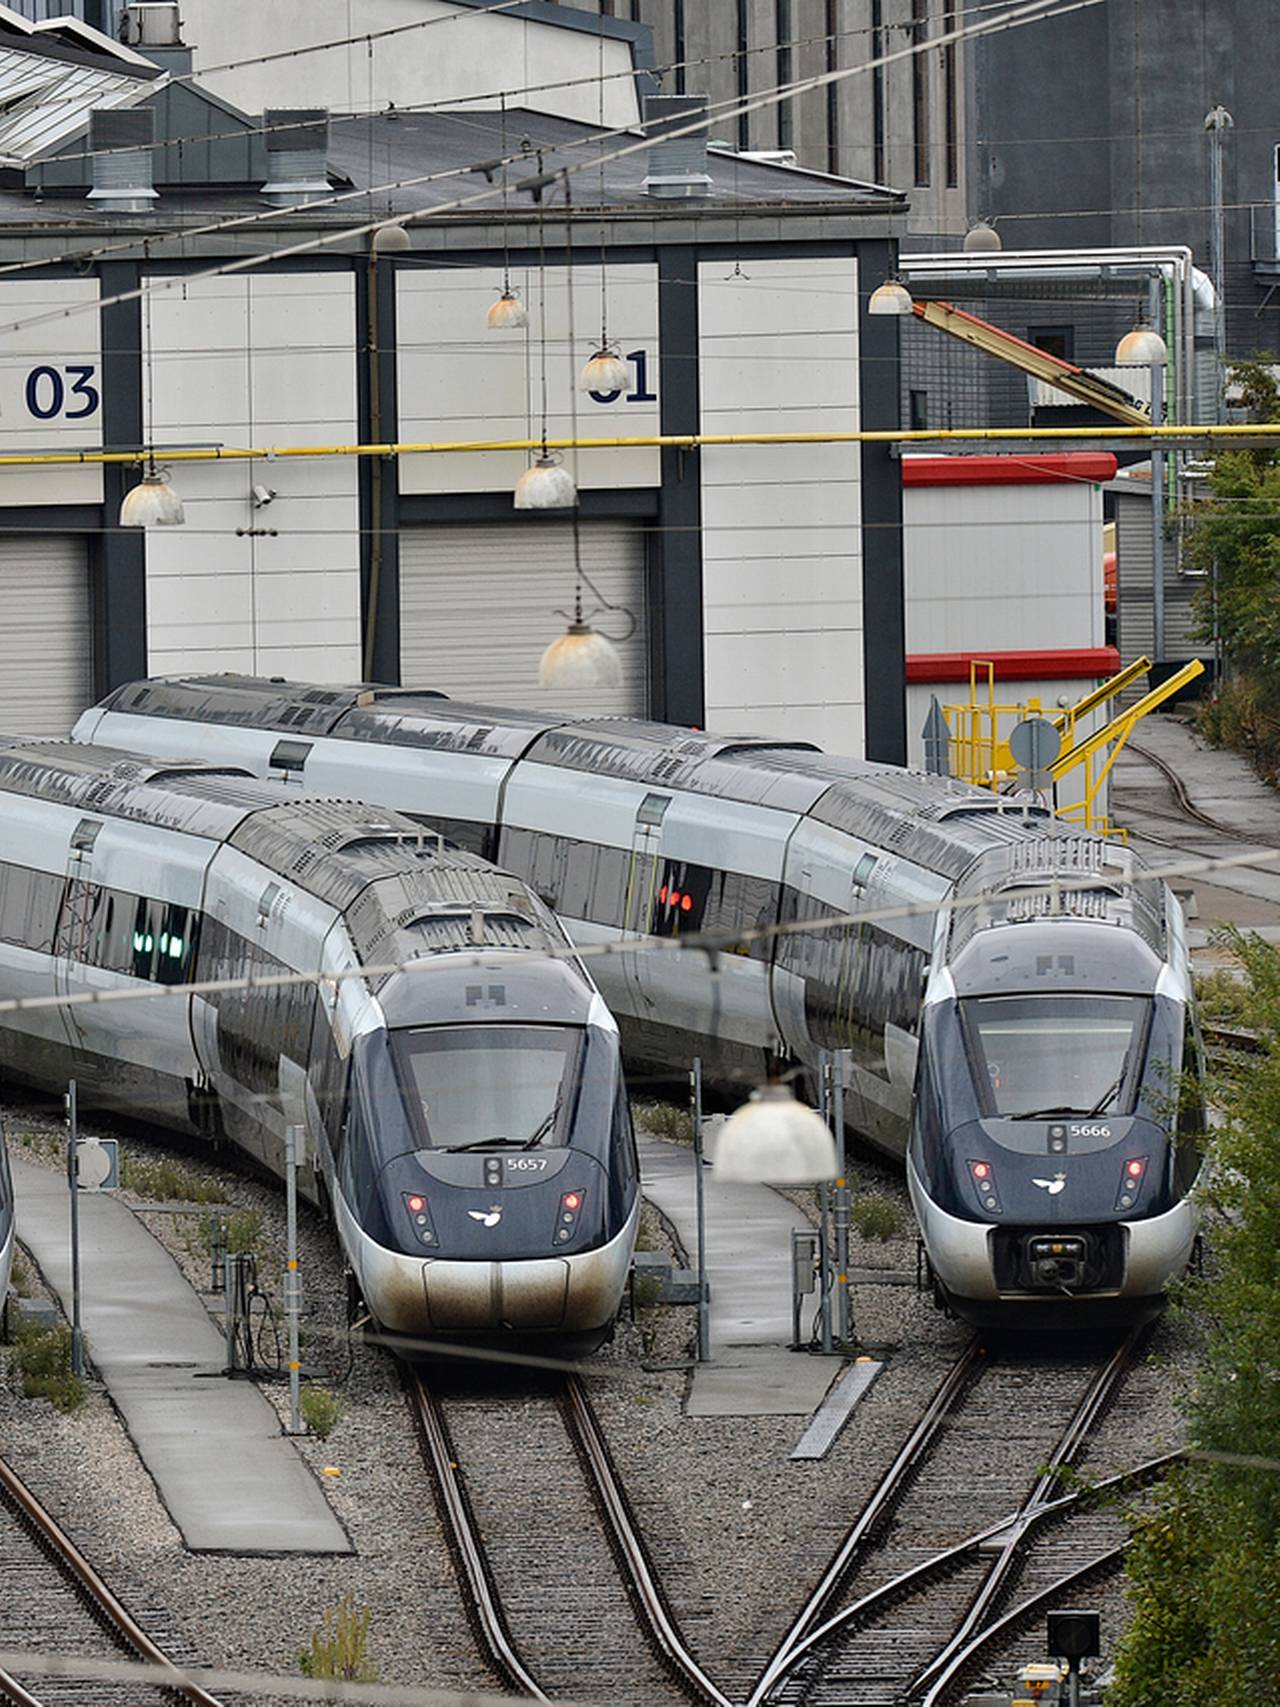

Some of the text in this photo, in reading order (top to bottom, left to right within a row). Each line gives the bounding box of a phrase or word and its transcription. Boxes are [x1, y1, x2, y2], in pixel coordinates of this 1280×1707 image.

[26, 367, 98, 420] 03
[1070, 1124, 1112, 1138] 5666
[507, 1158, 548, 1171] 5657
